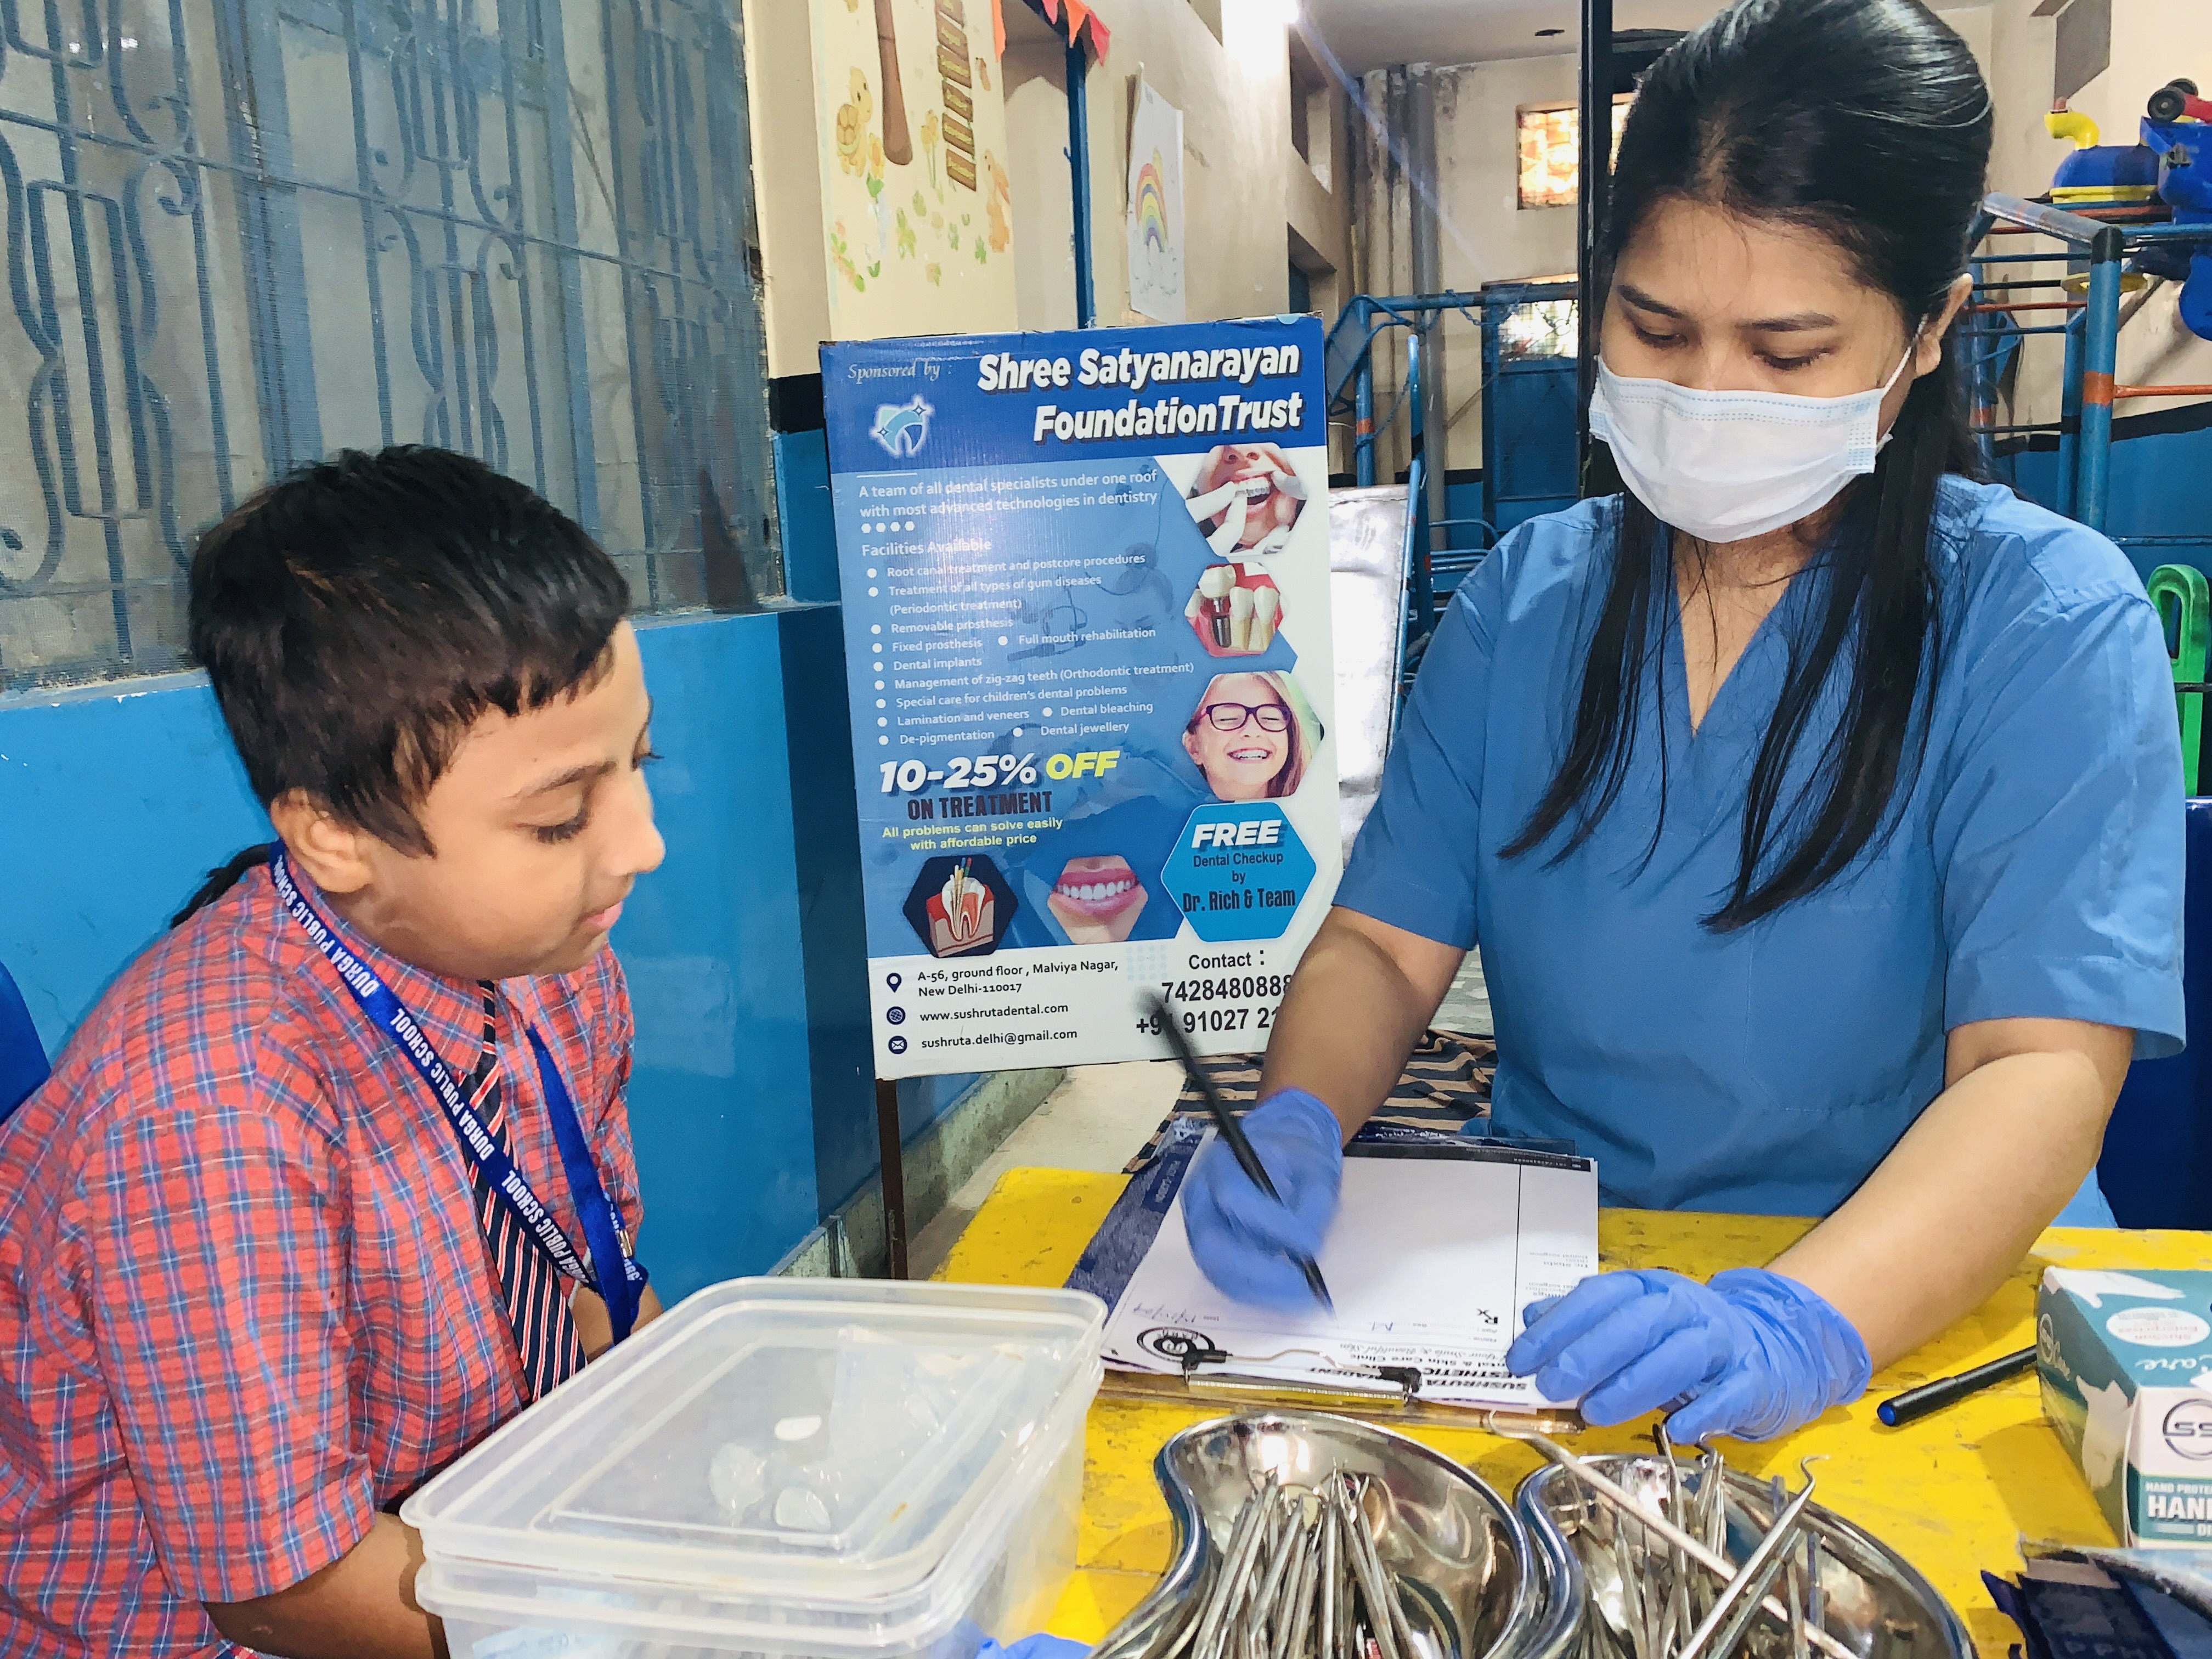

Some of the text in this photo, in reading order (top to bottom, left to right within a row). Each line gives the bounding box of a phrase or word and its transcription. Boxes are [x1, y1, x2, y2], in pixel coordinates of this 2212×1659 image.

[848, 359, 916, 384] Sponsored
[924, 358, 940, 380] by
[978, 344, 1300, 391] Shree Satyanarayan
[859, 469, 1158, 498] A team of all dental specialists under one roof
[860, 490, 1158, 517] with most advanced technologies in dentistry
[862, 538, 991, 556] Facilities Available
[887, 554, 1146, 577] Root canal treatment and postcore procedures
[889, 575, 1102, 596] Treatment of all types of gum diseases
[889, 598, 1022, 617] (Periodontic treatment)
[891, 618, 1014, 633] Removable prosthesis
[892, 628, 1156, 653] Fixed prosthesis Full mouth rehabilitation
[894, 657, 982, 672] Dental implants
[895, 662, 1194, 691] Management of zig-zag teeth (Orthodontic treatment)
[896, 695, 936, 709] Special
[938, 696, 962, 706] care
[964, 693, 980, 704] for
[1037, 687, 1073, 699] dental
[1076, 685, 1128, 699] problems
[897, 701, 1153, 726] Lamination and veneers Dental bleaching
[900, 721, 1130, 746] De-pigmentation Dental jewellery
[879, 750, 1120, 793] 10-25% OFF
[907, 791, 1052, 820] ON TREATMENT
[882, 817, 1063, 839] All problems can solve easily
[1191, 820, 1282, 849] FREE
[910, 833, 1037, 851] with affordable price
[1193, 851, 1284, 868] Dental Checkup
[1232, 870, 1246, 884] by
[1183, 888, 1296, 912] Dr. Rich & Team
[292, 901, 335, 953] PUBLIC
[330, 946, 380, 998] DURGA
[917, 970, 949, 983] A-56,
[952, 966, 993, 981] ground
[996, 965, 1023, 977] floor
[1033, 961, 1077, 975] Malviya
[1080, 960, 1119, 973] Nagar,
[1189, 952, 1251, 969] Contact
[918, 983, 1022, 997] New Delhi-110017
[919, 1003, 1069, 1022] www.sushrutadental.com
[1183, 1008, 1250, 1034] 91027
[921, 1029, 1077, 1049] sushruta.delhi@gmail.com
[390, 1007, 495, 1161] DURGA PUBLIC SCHOOL
[501, 1169, 544, 1224] SCHOOL
[535, 1217, 571, 1265] PUBLIC
[1423, 1367, 1525, 1379] ESTHETIC
[2146, 1481, 2175, 1493] HAND
